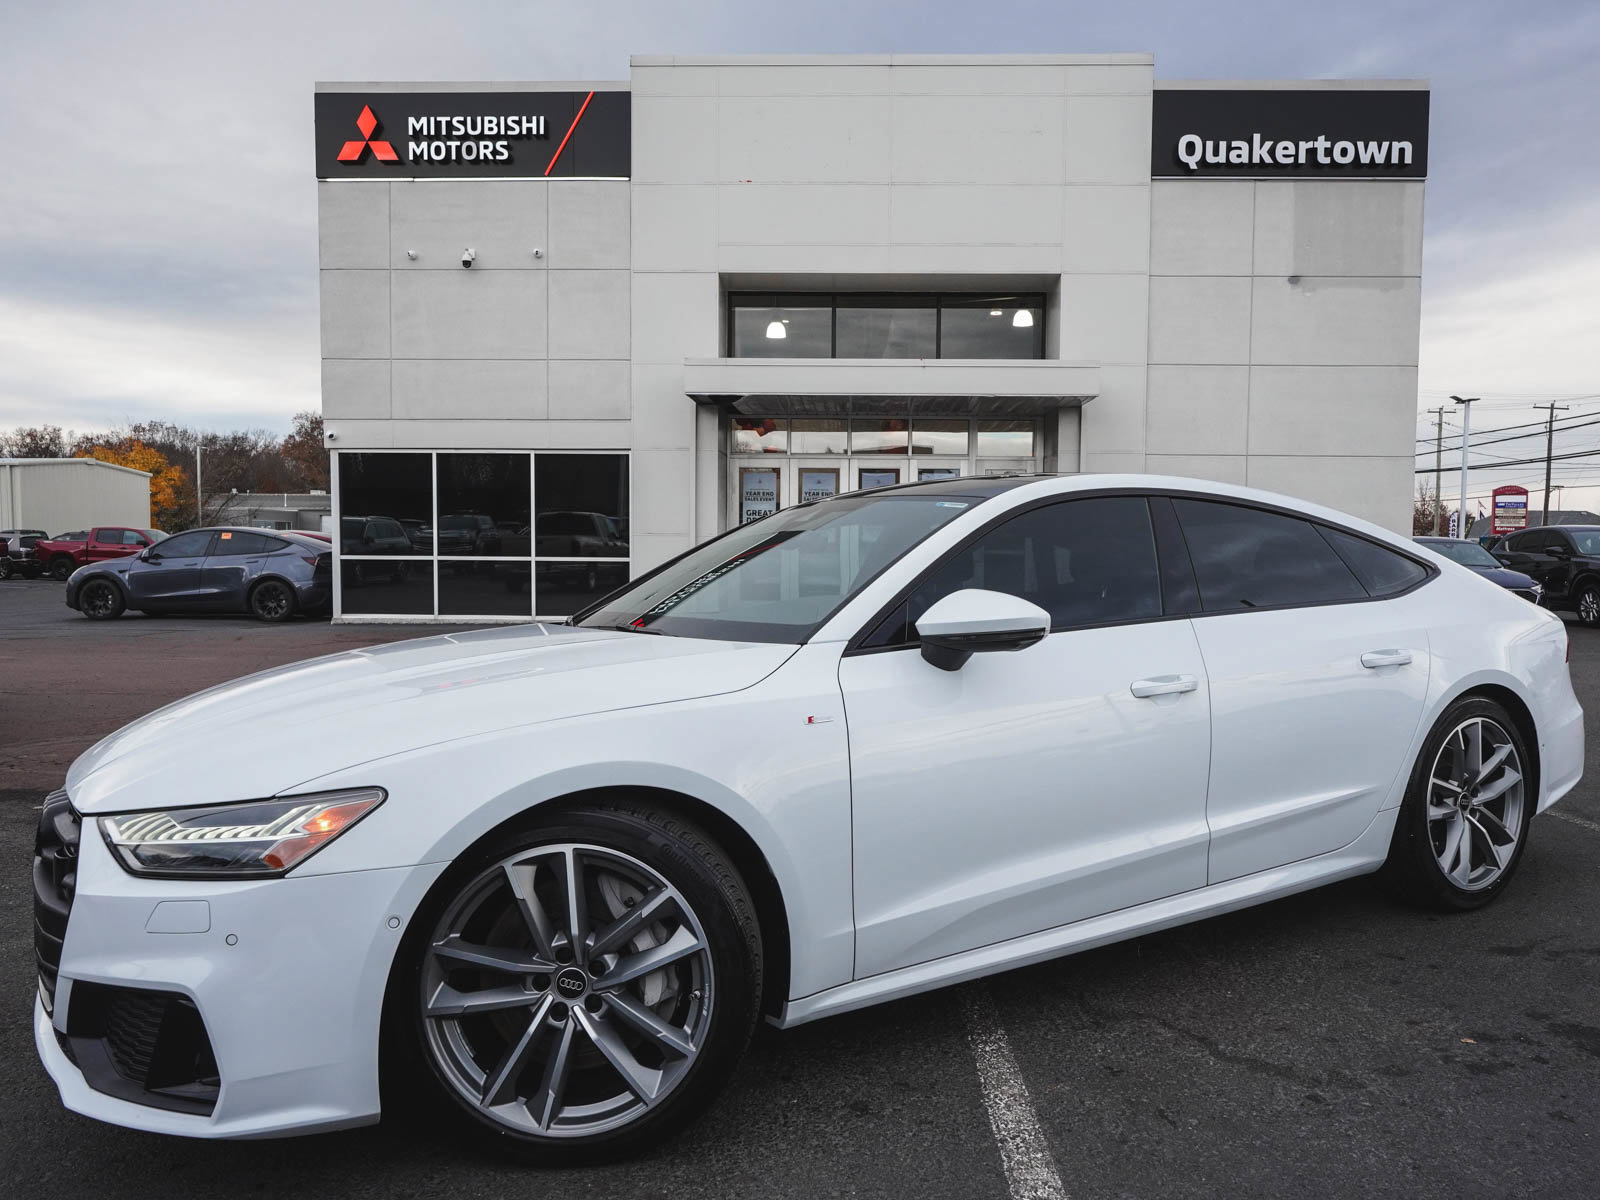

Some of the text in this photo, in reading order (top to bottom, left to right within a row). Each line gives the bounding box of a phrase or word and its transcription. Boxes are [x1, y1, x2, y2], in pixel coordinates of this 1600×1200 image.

[408, 116, 545, 136] MITSUBISHI
[408, 140, 509, 161] MOTORS
[1178, 133, 1413, 170] Quakertown
[745, 509, 773, 517] GREAT
